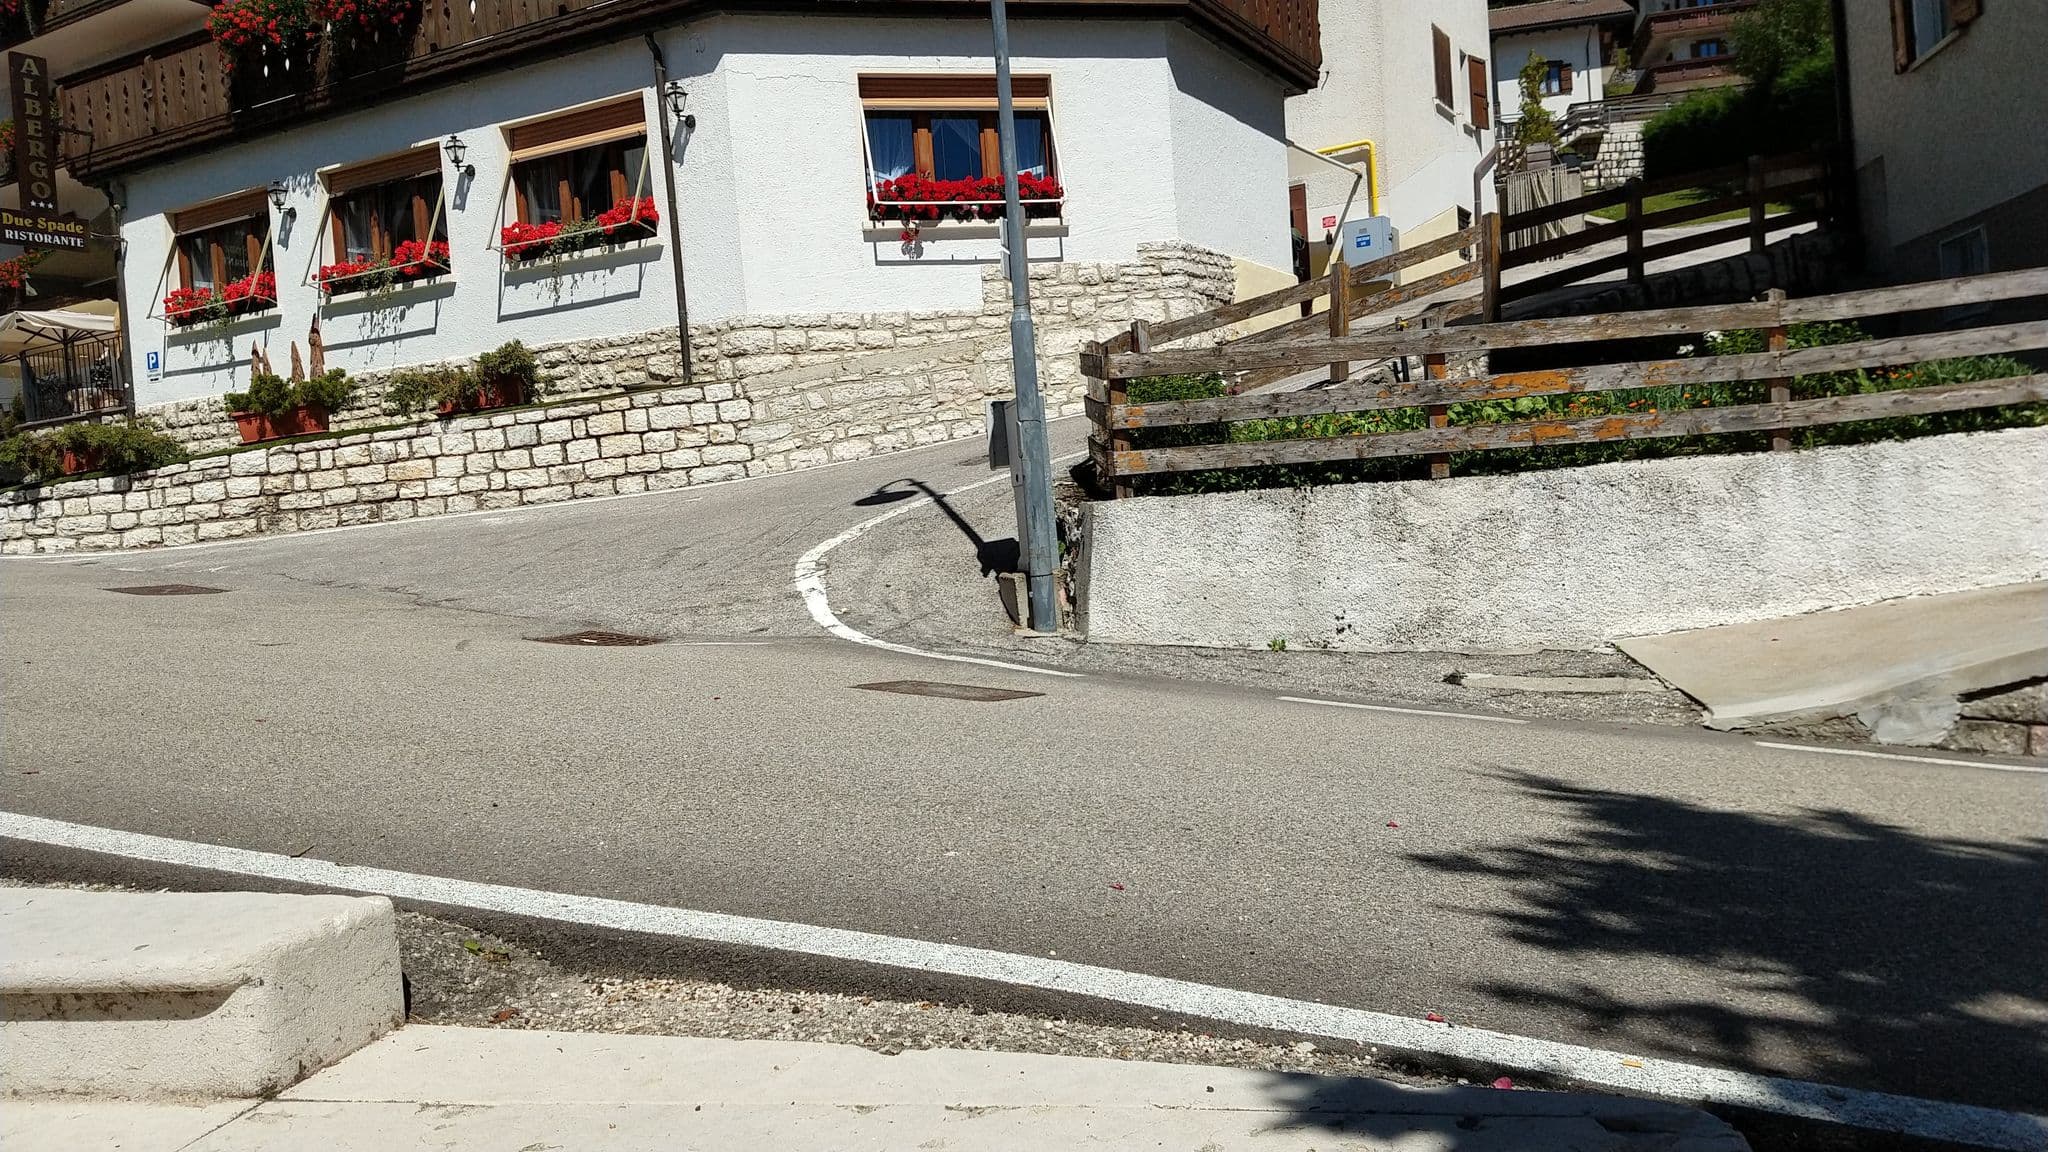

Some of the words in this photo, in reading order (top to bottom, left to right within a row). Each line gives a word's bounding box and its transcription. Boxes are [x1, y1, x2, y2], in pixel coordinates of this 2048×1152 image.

[20, 58, 50, 199] ALBERGO
[2, 212, 33, 227] Due
[37, 217, 84, 233] Spade
[5, 229, 84, 248] RISTORANTE
[149, 353, 157, 369] P
